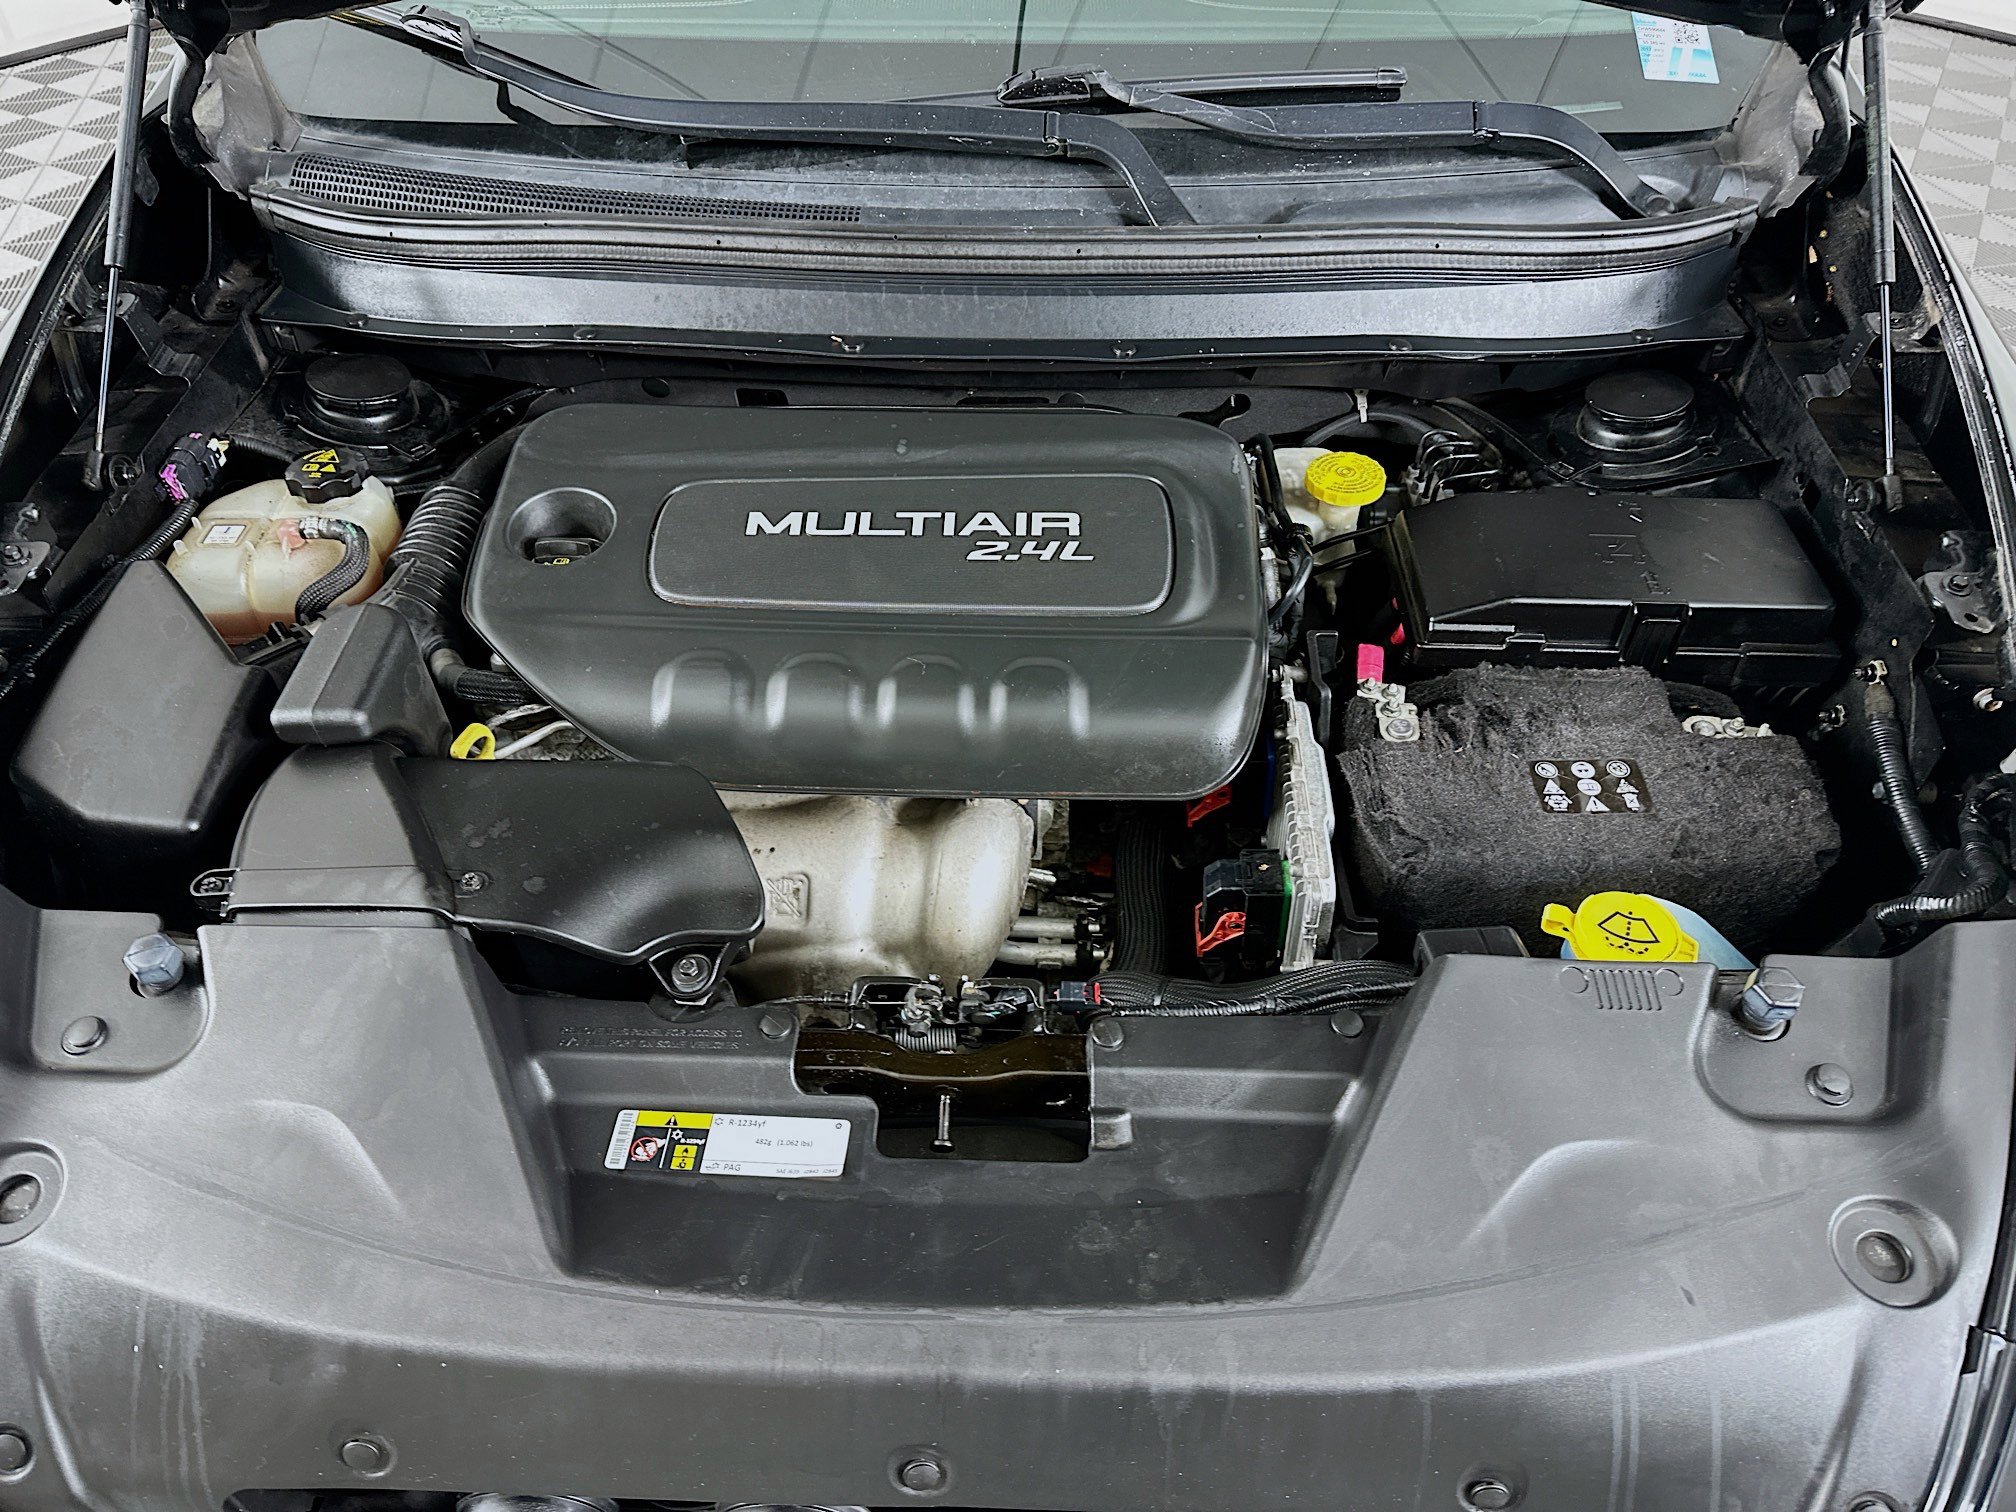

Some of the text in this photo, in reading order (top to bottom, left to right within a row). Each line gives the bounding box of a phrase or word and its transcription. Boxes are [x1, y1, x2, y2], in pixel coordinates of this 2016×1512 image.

[745, 511, 1080, 536] MULTIAIR
[965, 541, 1095, 561] 2.4L
[687, 1029, 727, 1038] ACCESS
[728, 1119, 766, 1128] R-1234yf
[777, 1139, 799, 1147] (1.062
[723, 1163, 741, 1171] PAG
